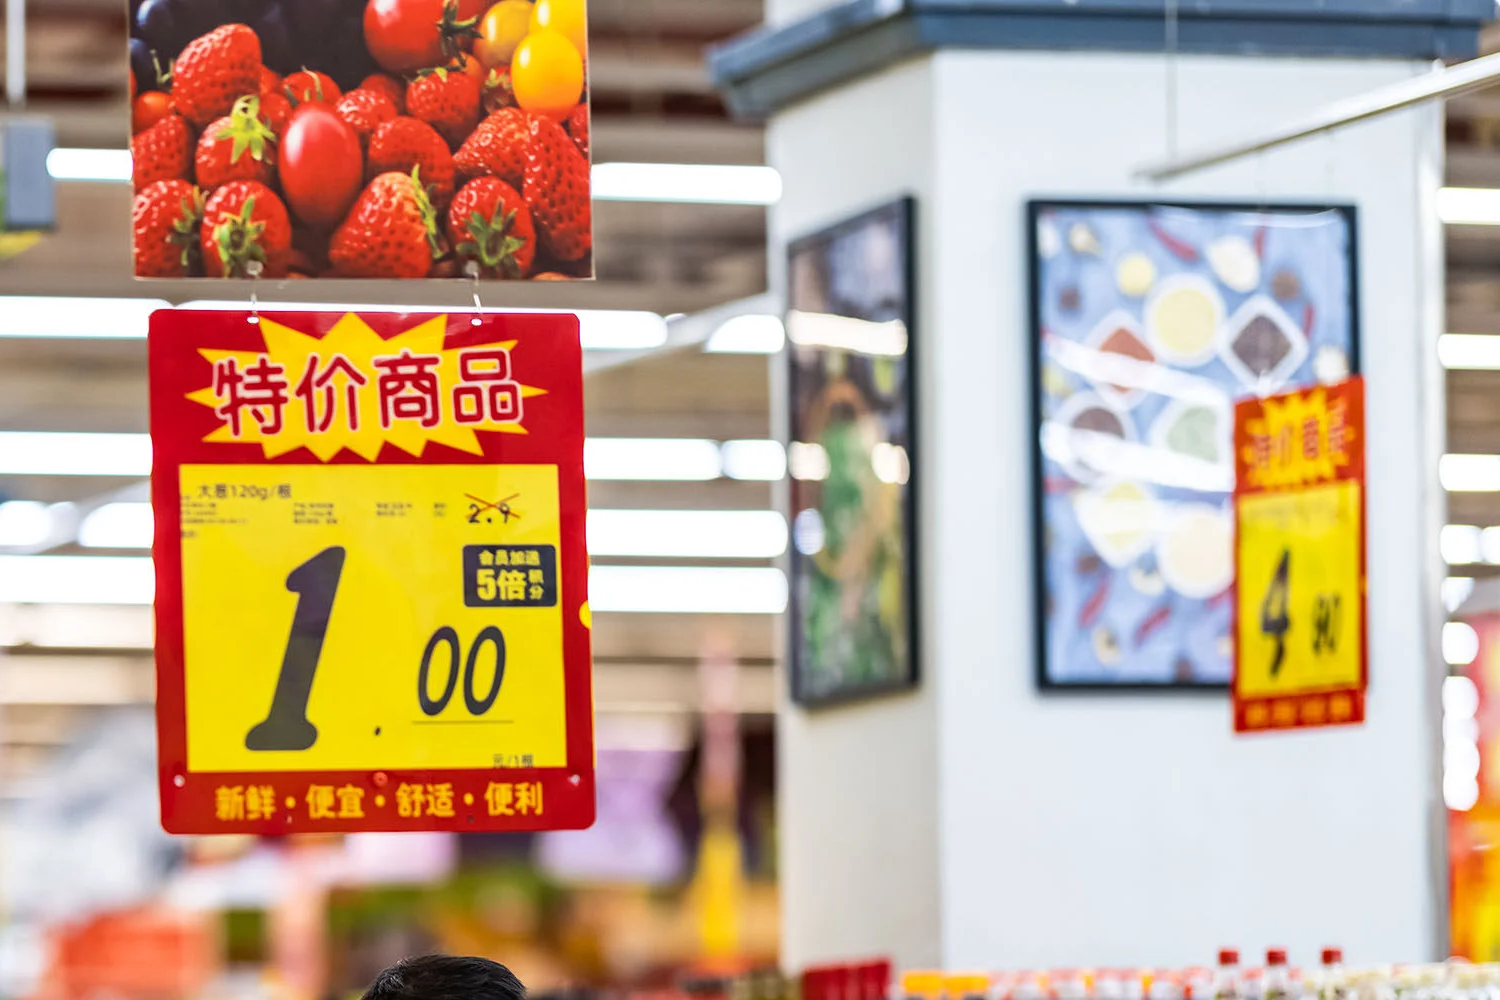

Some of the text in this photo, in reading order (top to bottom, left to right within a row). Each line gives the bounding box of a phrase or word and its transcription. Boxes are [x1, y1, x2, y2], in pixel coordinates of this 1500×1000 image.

[213, 347, 524, 438] 特价商品
[468, 503, 510, 524] 2.9
[476, 569, 527, 600] 5倍
[245, 546, 507, 751] 1 00
